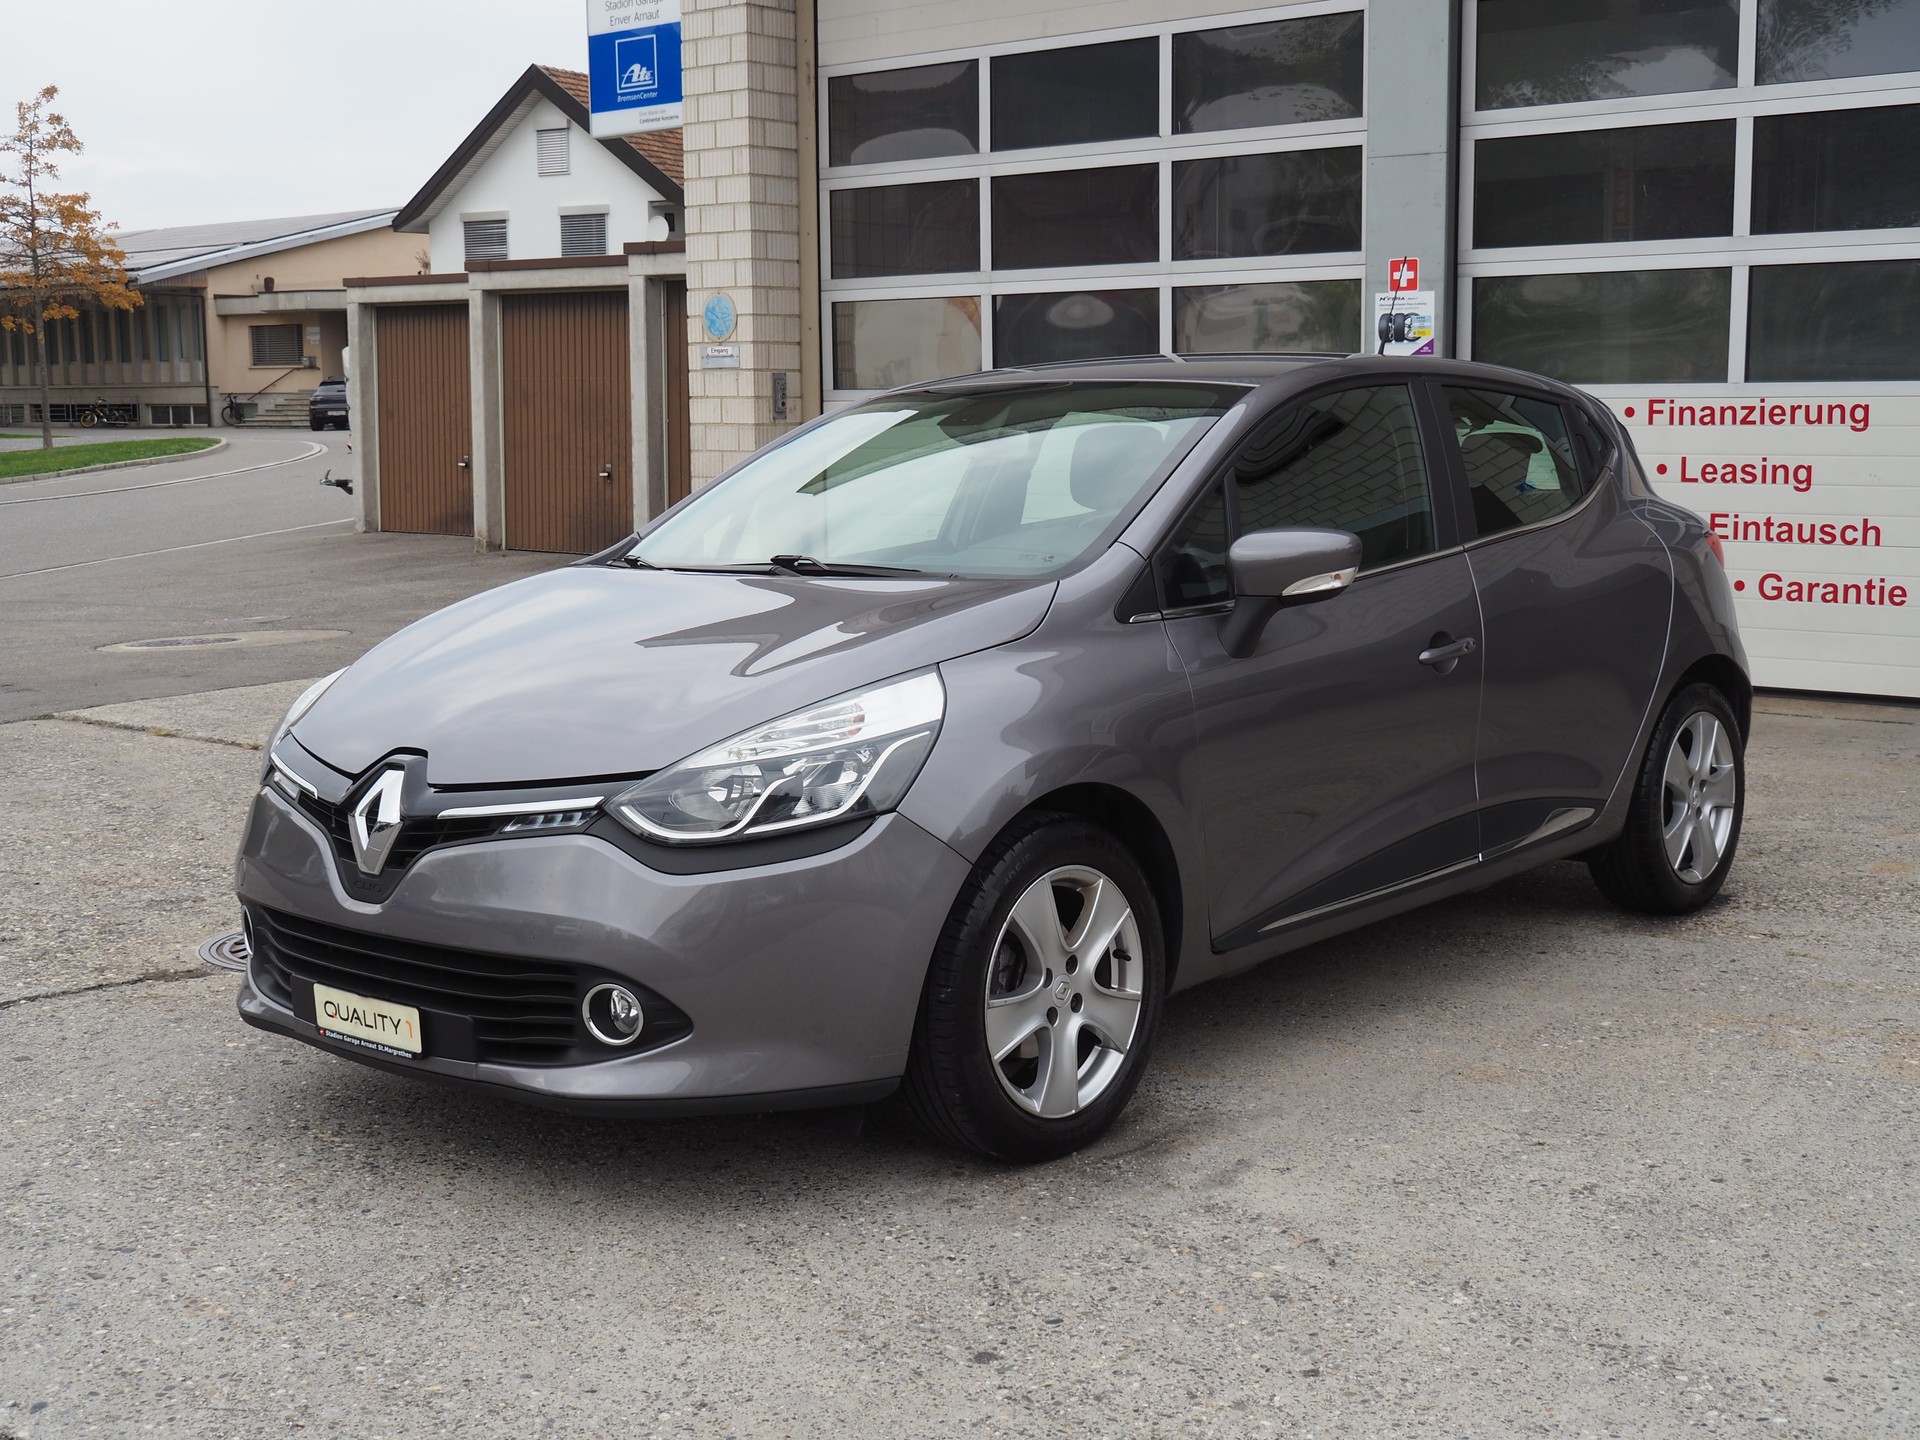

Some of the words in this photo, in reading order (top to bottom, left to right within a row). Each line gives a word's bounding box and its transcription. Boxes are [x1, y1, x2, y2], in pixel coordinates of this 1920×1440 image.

[605, 0, 633, 11] Stadion
[610, 15, 631, 26] Enver
[634, 9, 660, 22] Arnaut
[618, 92, 658, 103] BremsenCenter
[1647, 398, 1870, 432] Finanzierung
[1680, 456, 1813, 492] Leasing
[1709, 513, 1882, 546] Eintausch
[1758, 573, 1907, 607] Garantie
[324, 1000, 401, 1035] QUALITY
[405, 1020, 413, 1039] 1
[325, 1030, 343, 1041] Stadion
[343, 1035, 361, 1045] Garage
[361, 1039, 377, 1050] Arnaut
